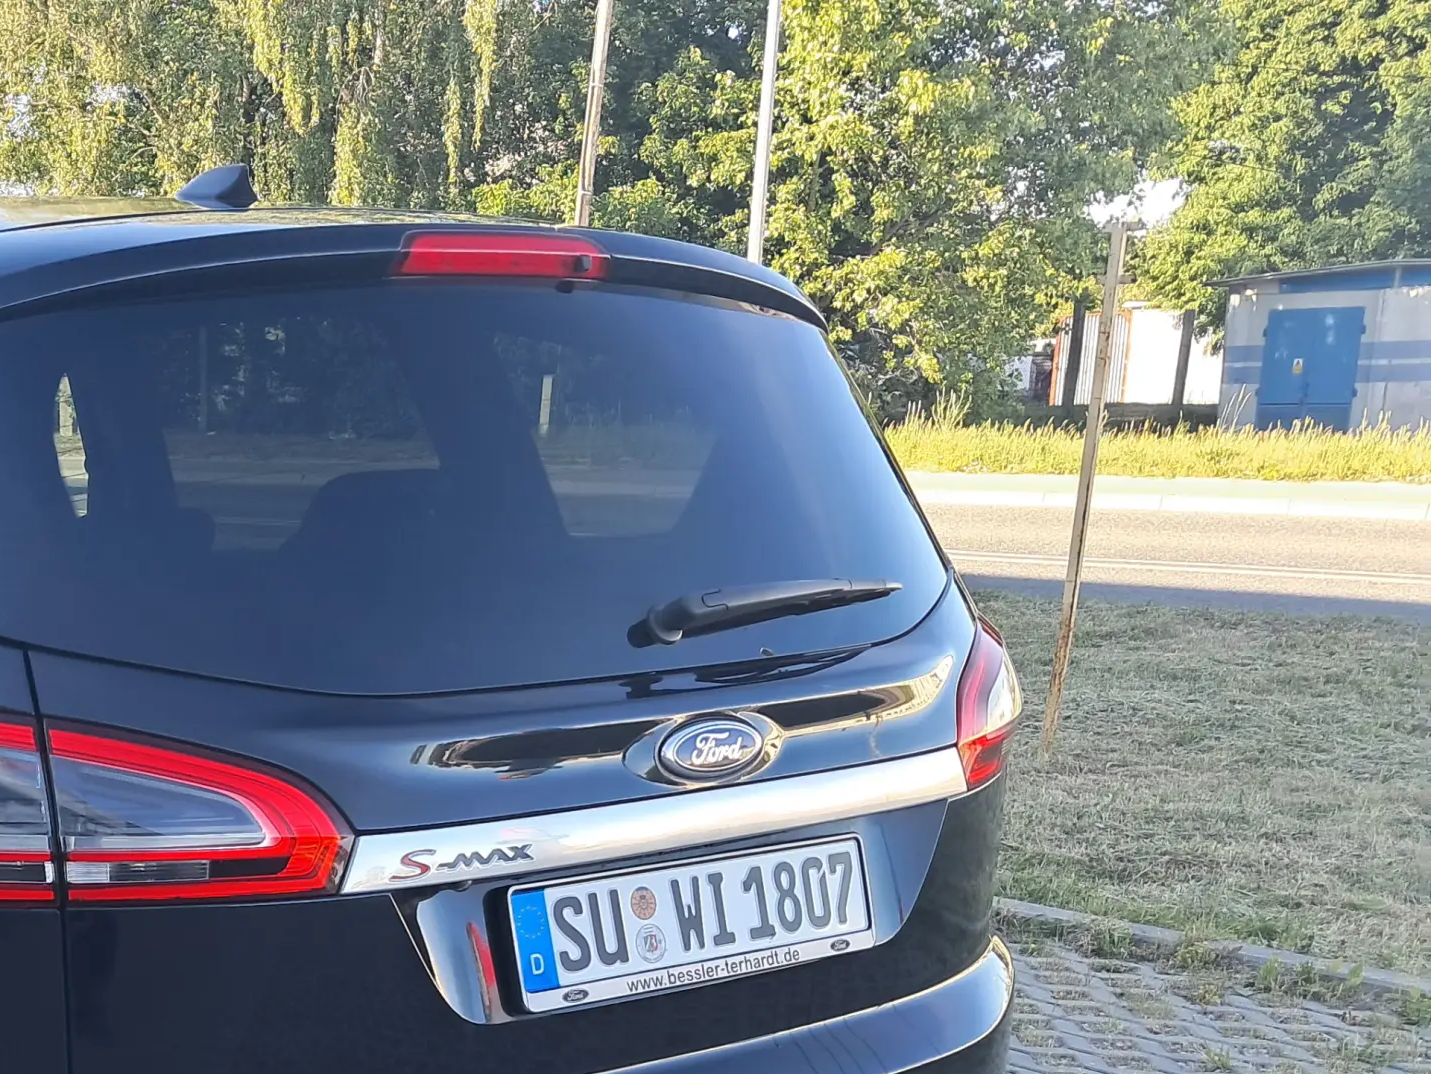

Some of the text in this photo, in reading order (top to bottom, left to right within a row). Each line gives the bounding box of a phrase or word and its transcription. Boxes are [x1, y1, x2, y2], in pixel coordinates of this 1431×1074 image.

[691, 731, 743, 765] Ford
[552, 851, 853, 971] SU WI 1807
[530, 953, 545, 975] D
[626, 948, 801, 993] www.bessler-terhardt.de
